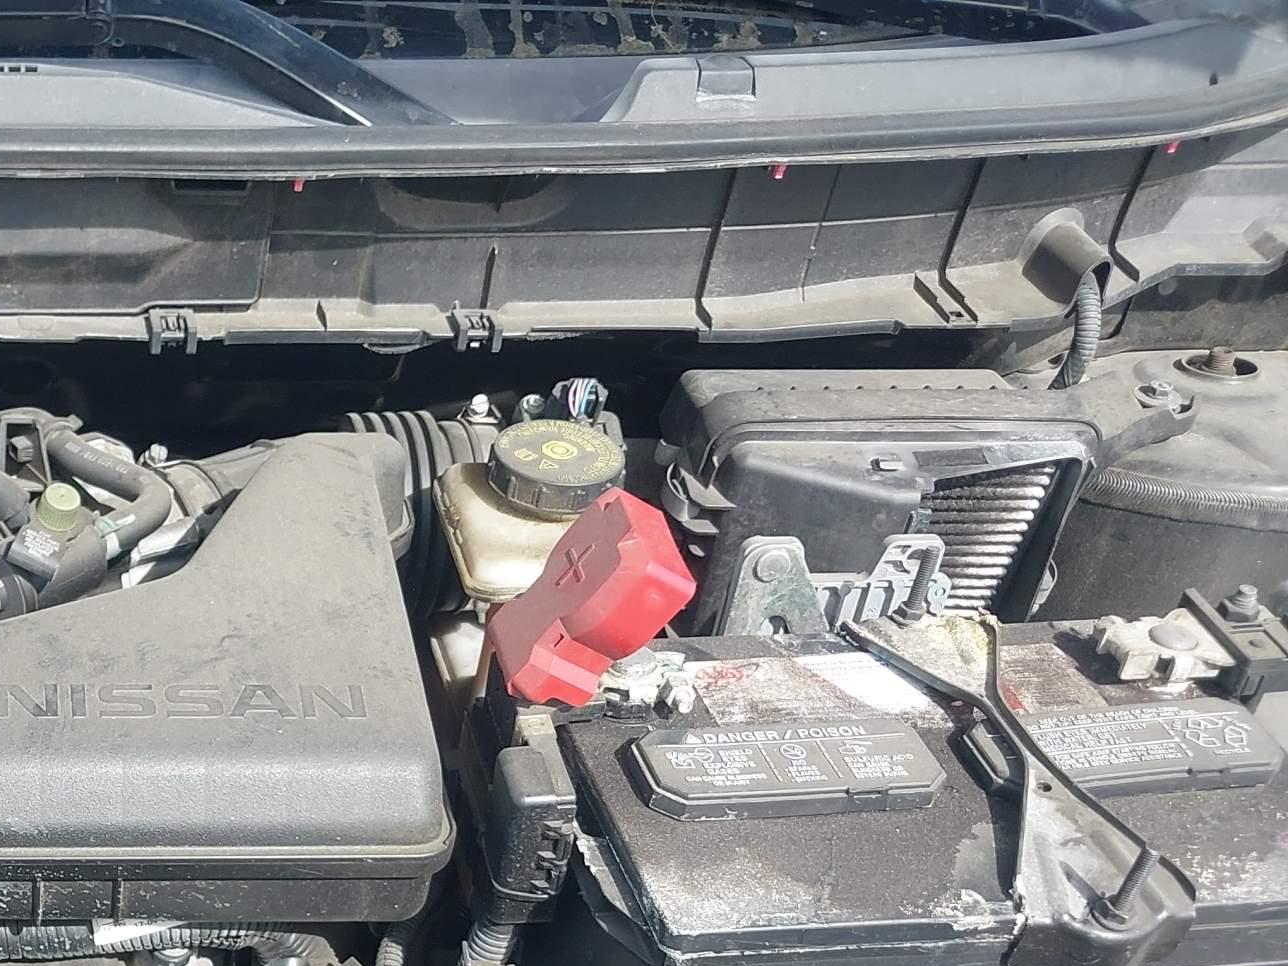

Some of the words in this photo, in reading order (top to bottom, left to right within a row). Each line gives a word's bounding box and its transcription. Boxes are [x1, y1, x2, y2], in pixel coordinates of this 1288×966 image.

[703, 731, 780, 744] DANGER
[783, 729, 793, 740] /
[796, 725, 866, 739] POISON
[1088, 723, 1147, 734] IMMEDIATELY
